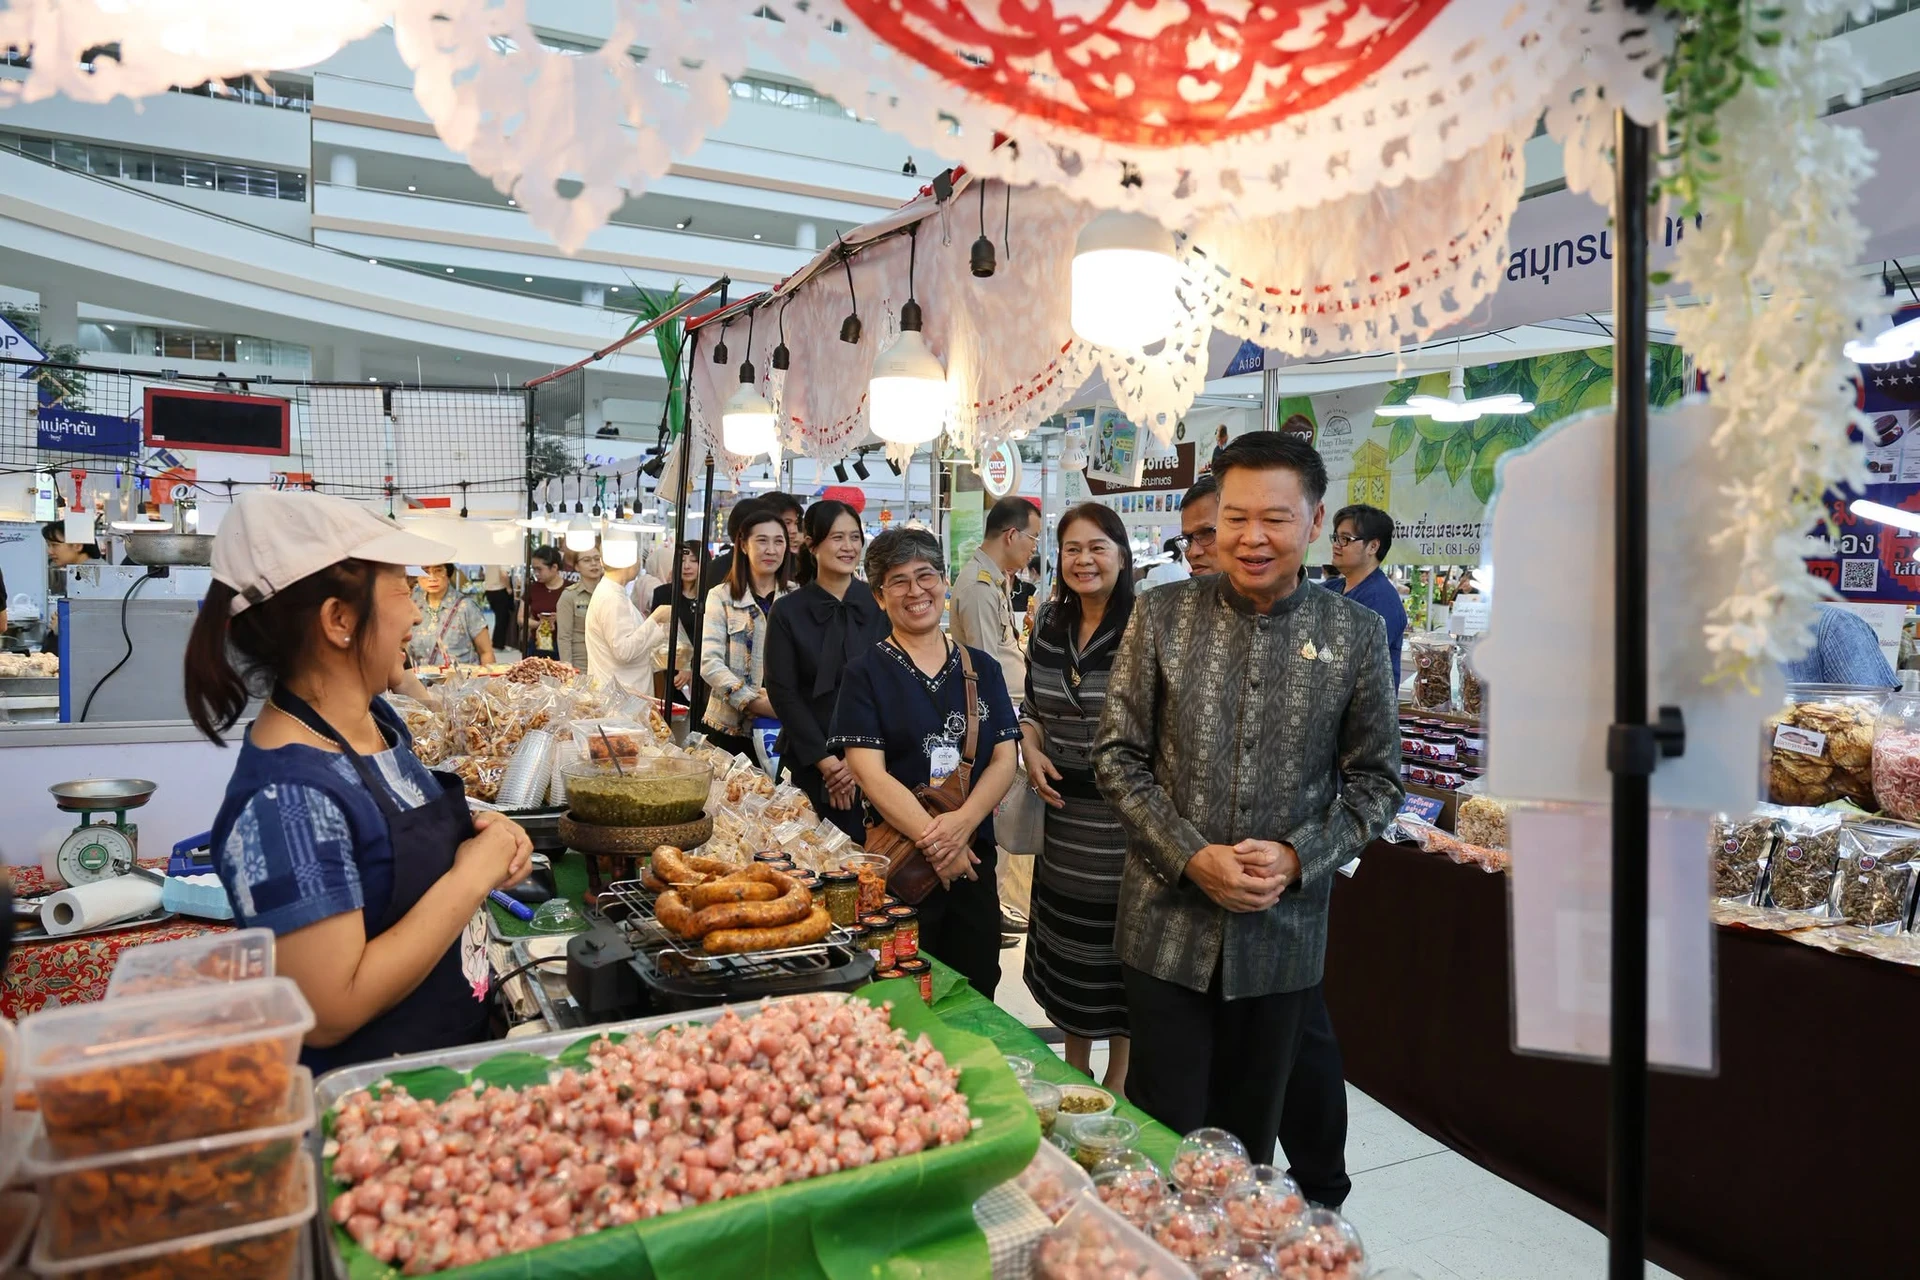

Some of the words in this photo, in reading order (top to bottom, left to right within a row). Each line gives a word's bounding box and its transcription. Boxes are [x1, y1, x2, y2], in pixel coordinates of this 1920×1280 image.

[1239, 356, 1261, 371] A180
[38, 417, 96, 437] แม่คำตัน
[1420, 542, 1435, 555] Tel
